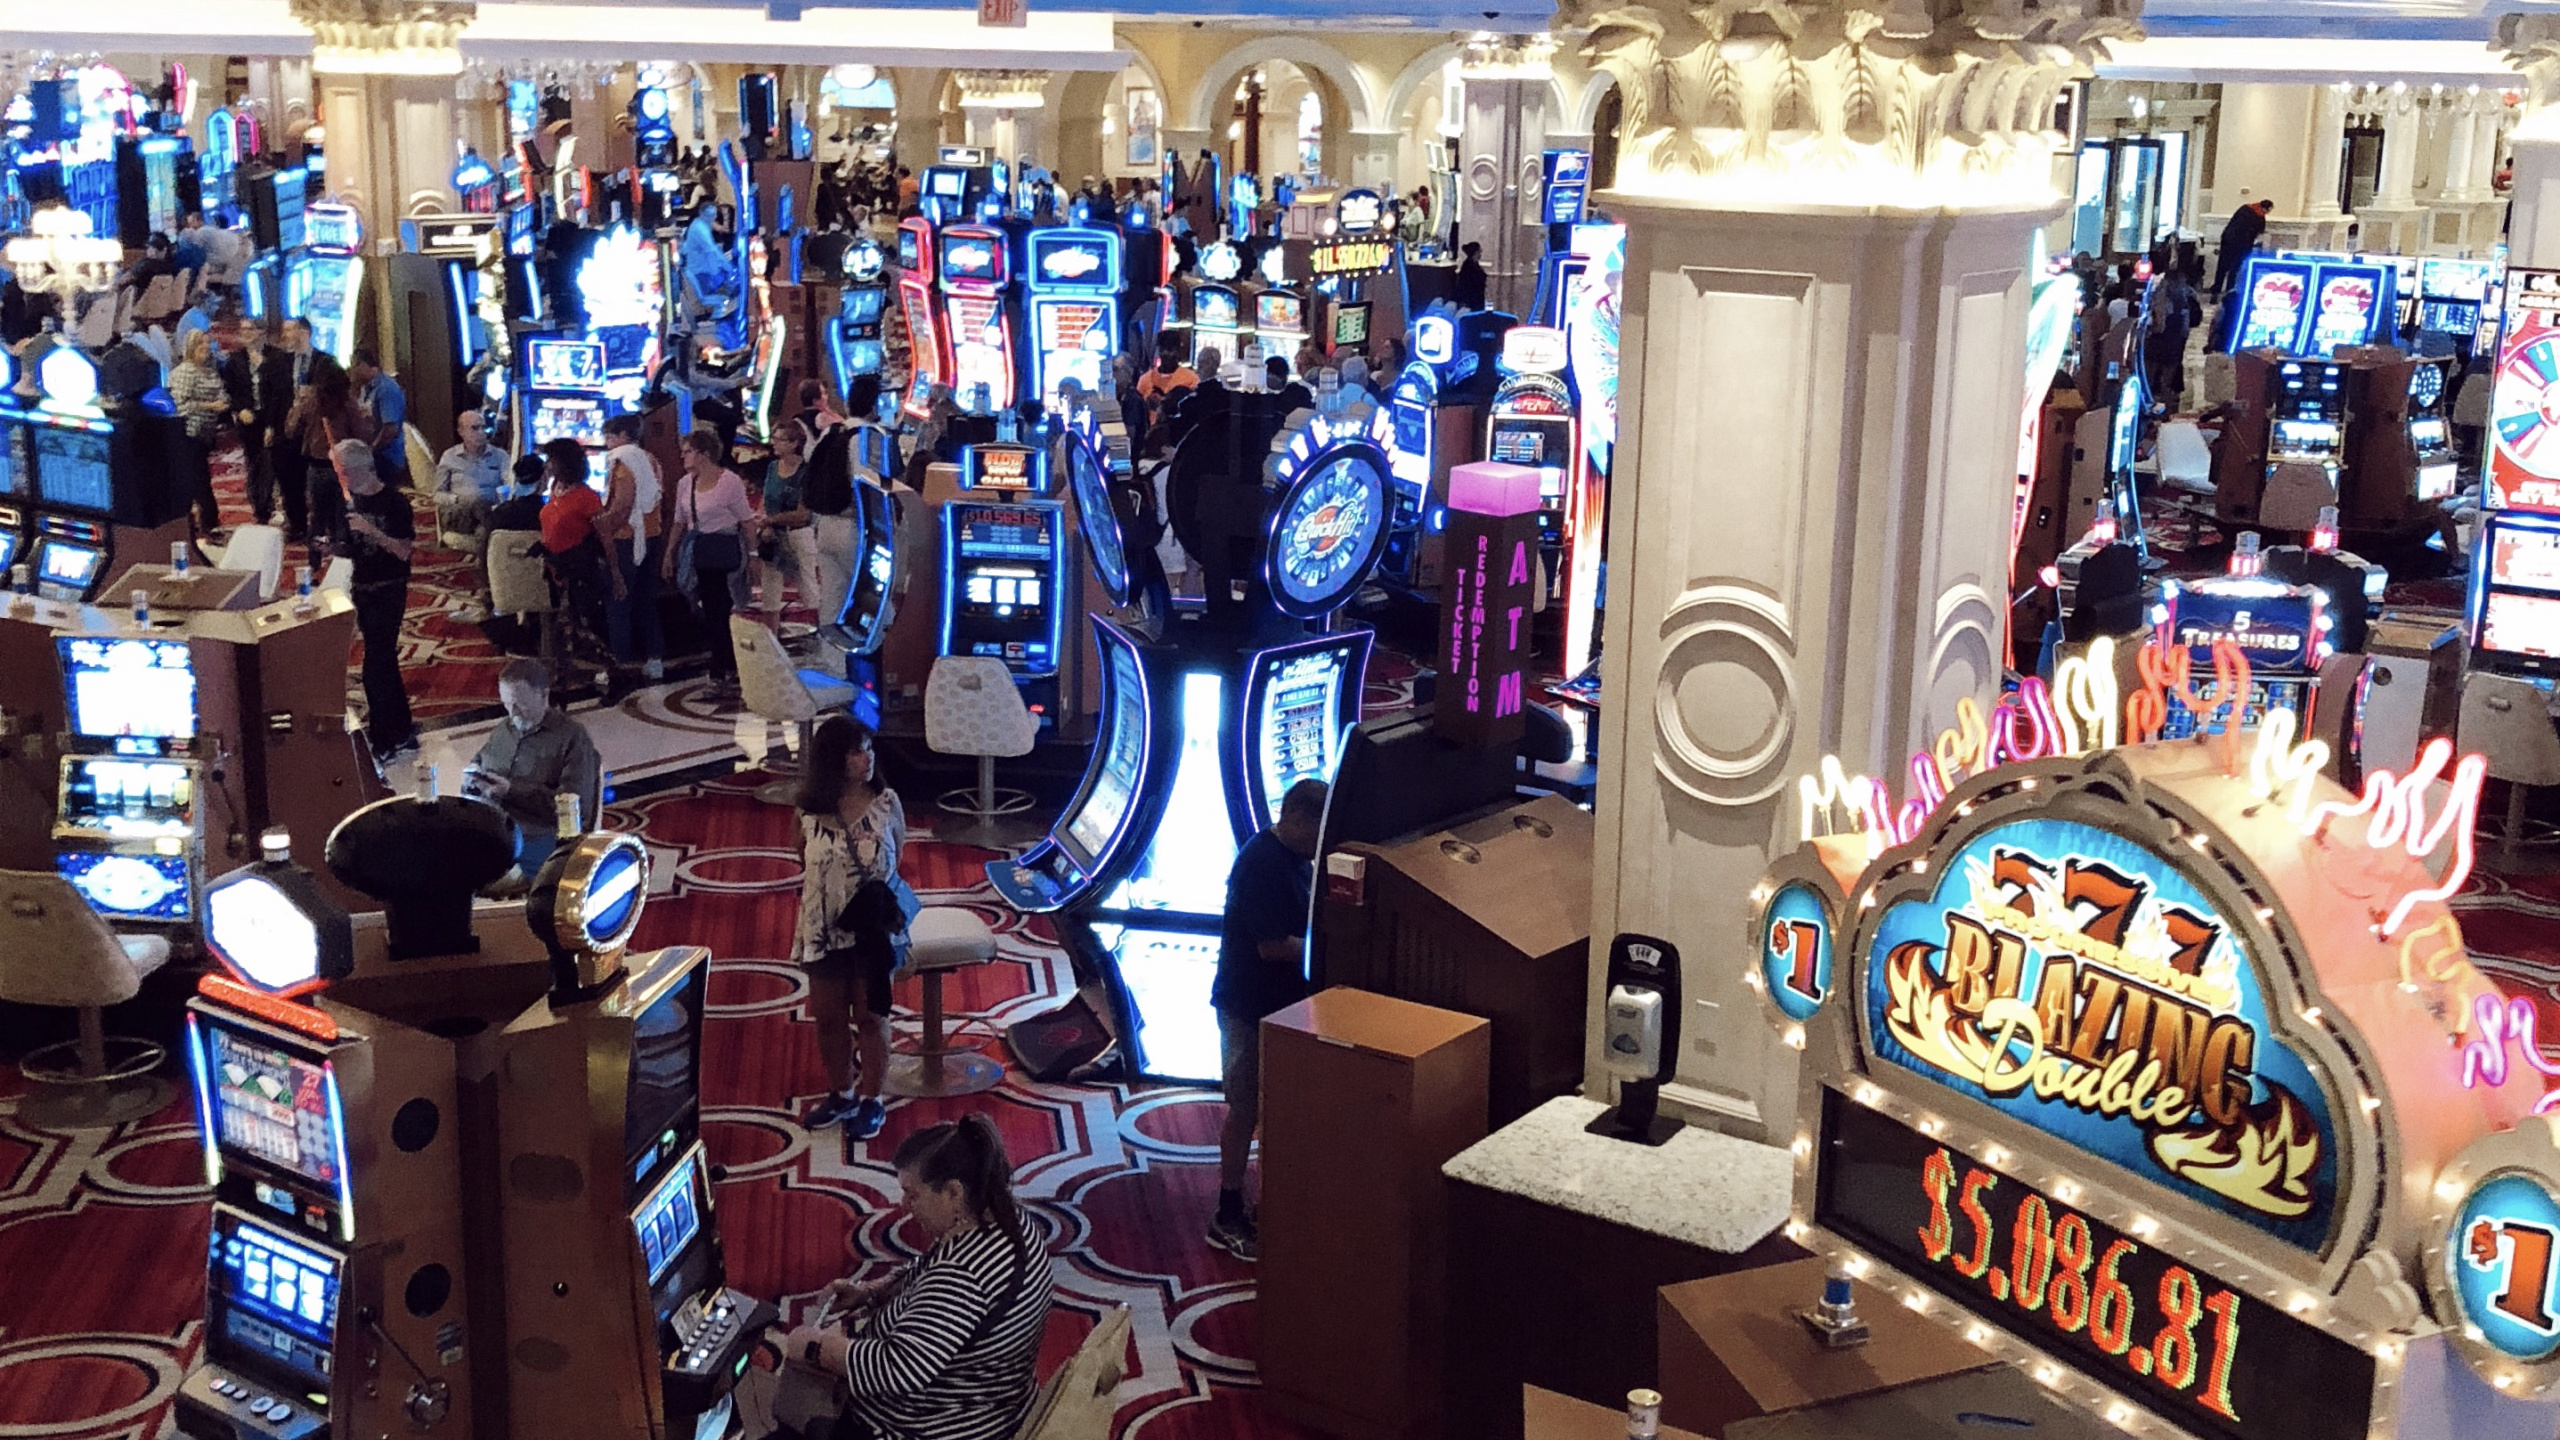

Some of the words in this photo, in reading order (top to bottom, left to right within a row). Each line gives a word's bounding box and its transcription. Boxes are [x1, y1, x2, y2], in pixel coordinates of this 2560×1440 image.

[980, 475, 1028, 487] GAME!
[984, 451, 1026, 466] HOT
[987, 465, 1022, 476] NEW
[1452, 569, 1466, 674] TICKET
[1467, 535, 1487, 712] REDEMPTION
[1496, 541, 1528, 718] ATM
[2181, 628, 2300, 651] TREASURES
[2233, 610, 2252, 632] 5
[1772, 920, 1822, 1000] $1
[1984, 902, 2232, 1008] PROGRESSIVE
[1945, 910, 2255, 1126] BLAZING
[1982, 997, 2193, 1127] Double
[2468, 1220, 2554, 1332] $1
